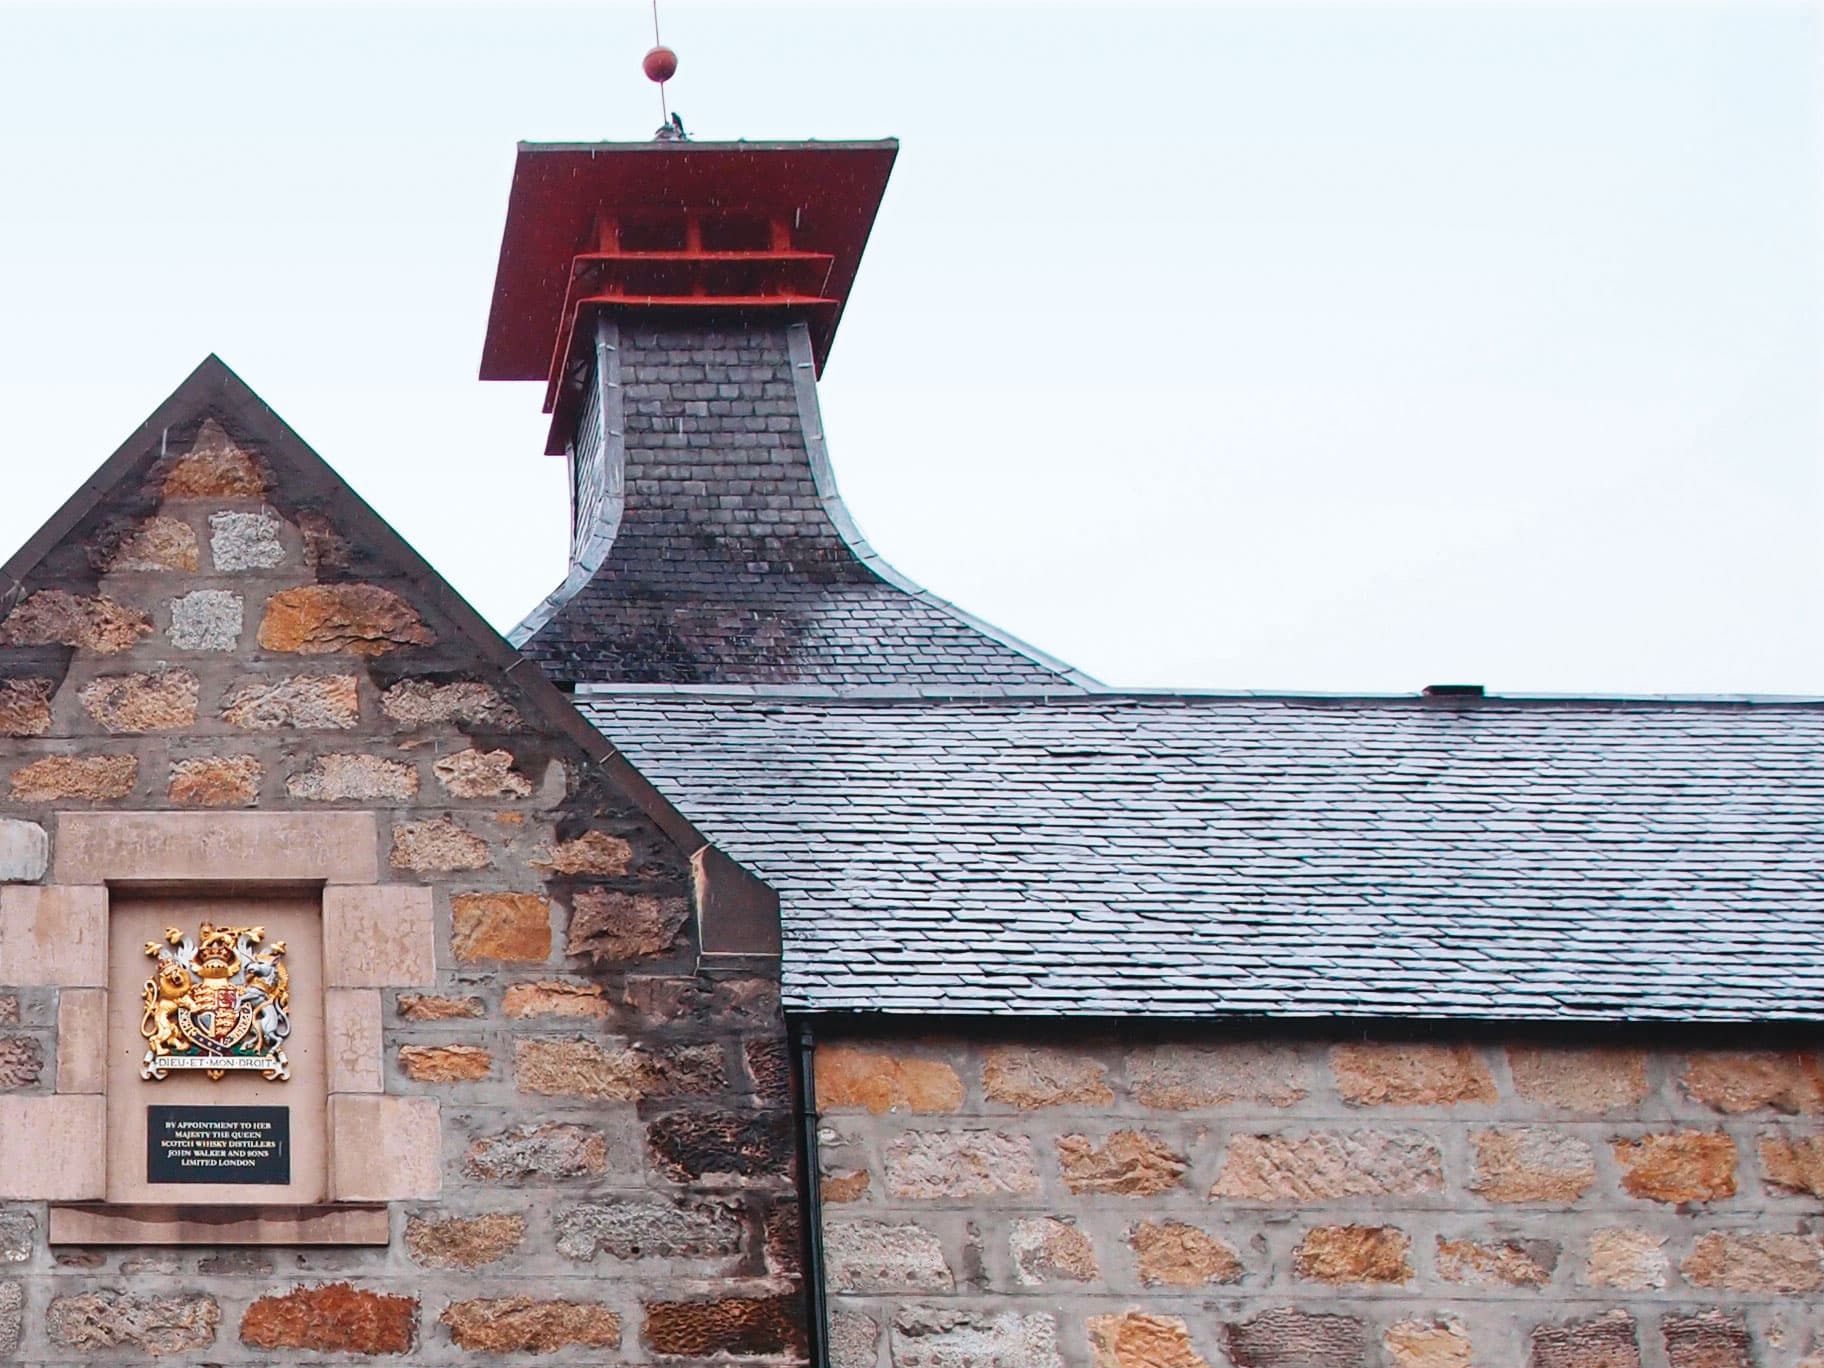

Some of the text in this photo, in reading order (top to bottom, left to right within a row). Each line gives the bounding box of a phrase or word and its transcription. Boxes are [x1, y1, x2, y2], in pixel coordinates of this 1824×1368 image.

[165, 1121, 176, 1129] BY
[177, 1121, 238, 1129] APPOINTMENT
[252, 1122, 272, 1130] HER
[175, 1131, 210, 1139] MAJESTY
[231, 1131, 262, 1139] QUEEN
[160, 1140, 276, 1148] SCOTCH WHISKY DISTILLERS
[167, 1149, 191, 1158] JOHN
[193, 1149, 227, 1157] WALKER
[227, 1149, 246, 1157] AND
[181, 1159, 256, 1167] LIMITED LONDON
